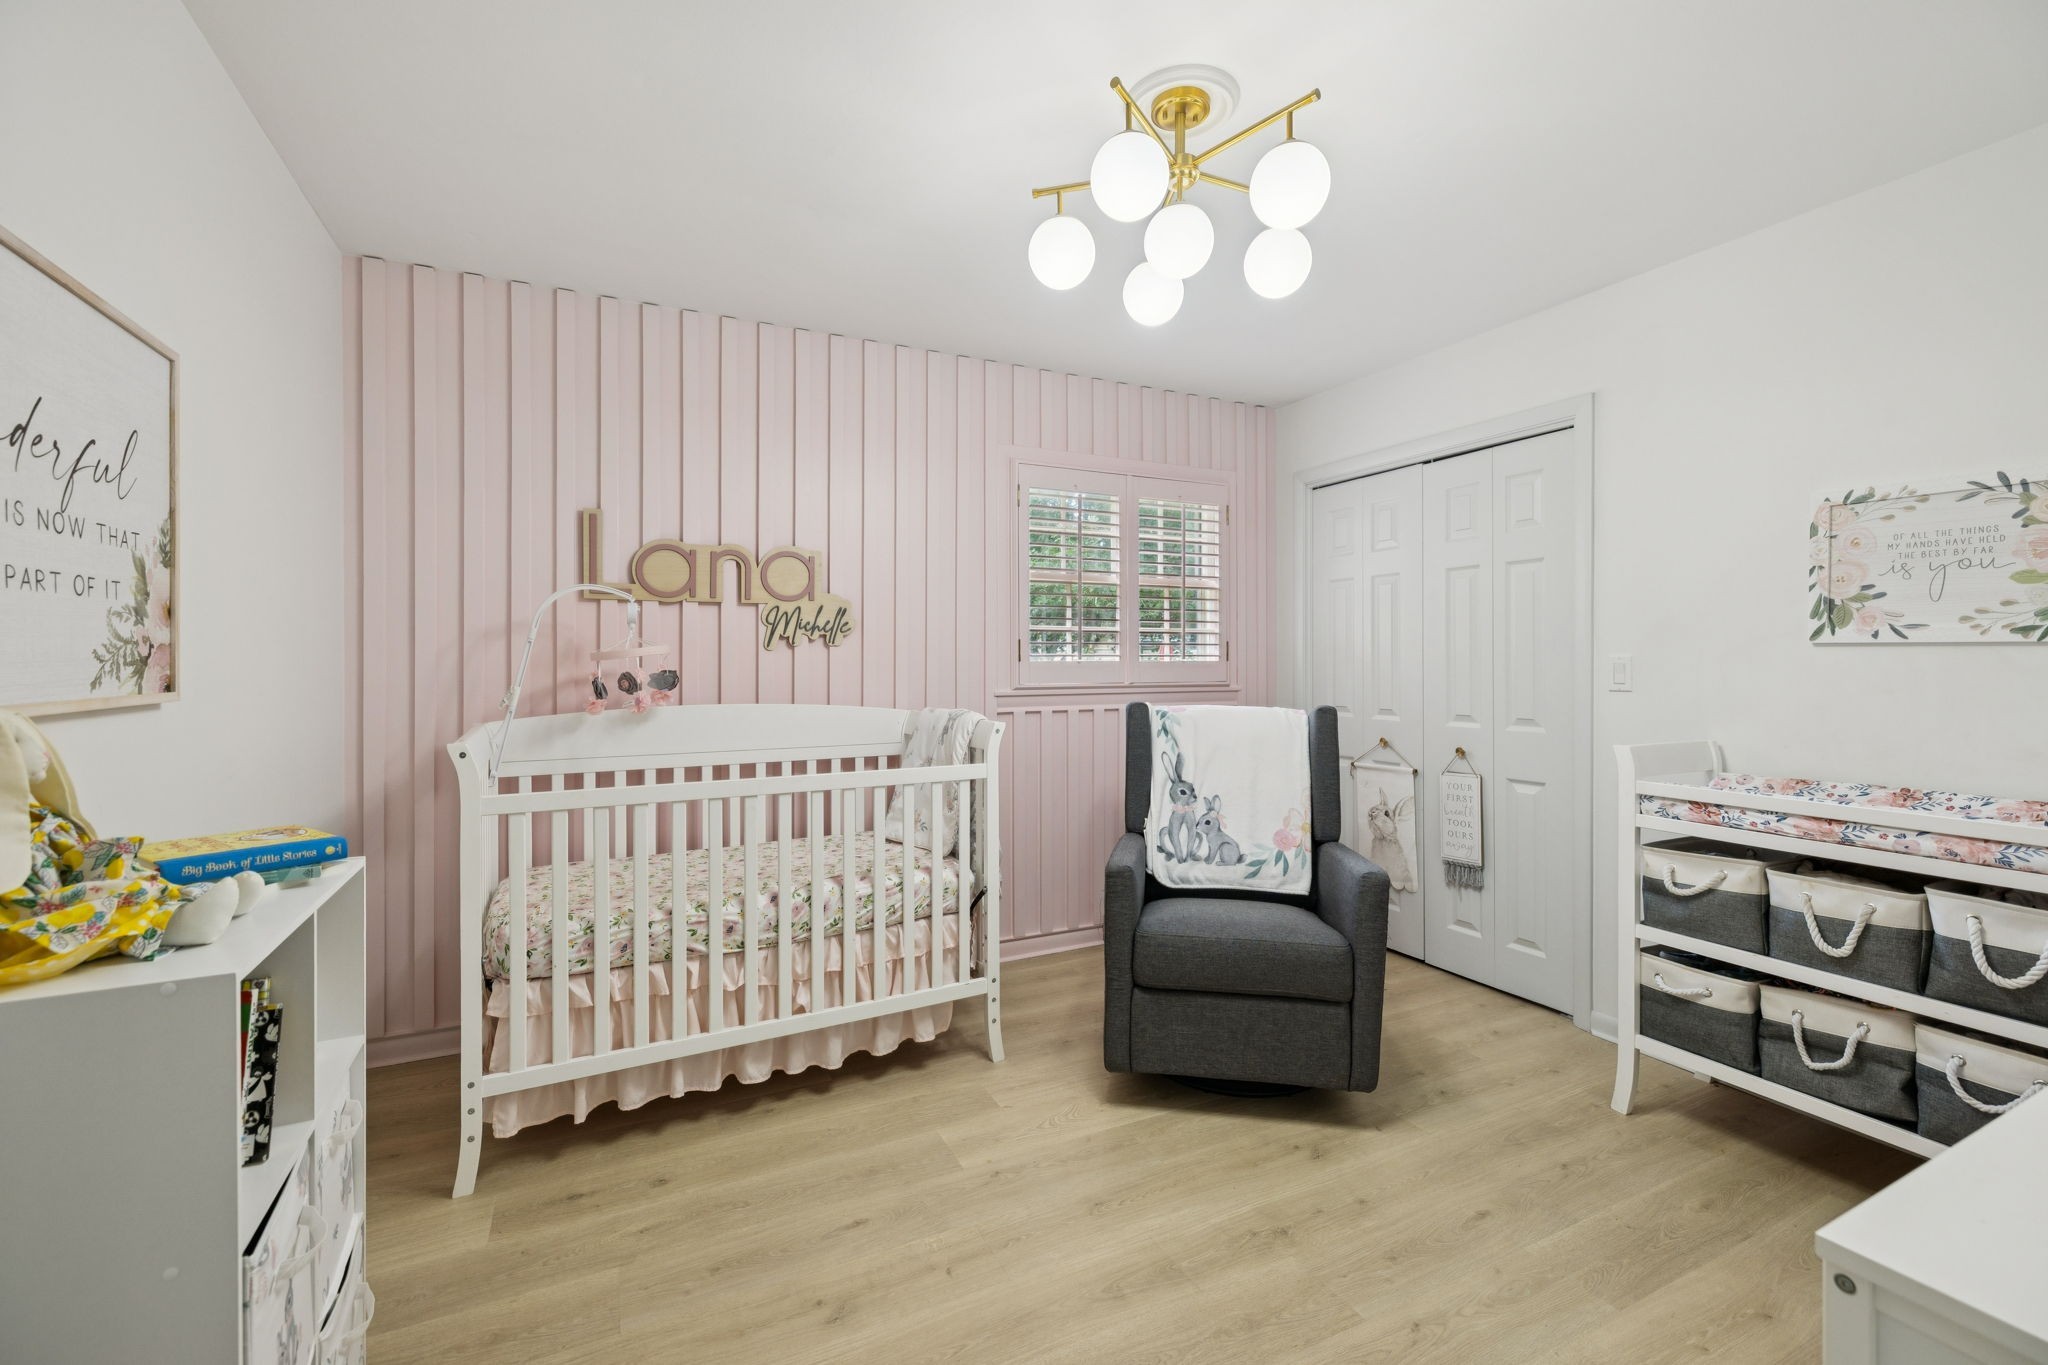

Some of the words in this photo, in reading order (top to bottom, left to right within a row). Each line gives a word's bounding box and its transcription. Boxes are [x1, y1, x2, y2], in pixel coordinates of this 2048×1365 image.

[0, 396, 138, 513] derful
[4, 498, 25, 526] IS
[37, 507, 85, 539] NOW
[96, 522, 140, 551] THAT
[1893, 532, 1905, 541] OF
[1910, 530, 1928, 540] ALL
[1935, 528, 1954, 538] THE
[1959, 524, 2000, 535] THINGS
[1887, 542, 1901, 551] MY
[1905, 539, 1940, 549] HANDS
[1945, 536, 1973, 547] HAVE
[1979, 534, 2006, 544] HELD
[1898, 551, 1915, 560] THE
[1921, 548, 1948, 559] BEST
[1953, 547, 1968, 557] BY
[1973, 545, 1995, 555] FAR
[587, 511, 818, 603] Lana
[5, 563, 61, 594] PART
[73, 574, 95, 597] OF
[105, 578, 120, 600] IT
[1878, 559, 1915, 581] is
[1928, 557, 2017, 602] you
[764, 605, 852, 646] Michelle
[1446, 781, 1473, 792] YOUR
[1446, 793, 1473, 804] FIRST
[1447, 818, 1473, 829] TOOK
[1447, 829, 1474, 841] OURS
[182, 865, 203, 878] Big
[205, 860, 238, 873] Book
[240, 857, 253, 870] of
[254, 853, 281, 866] Little
[282, 848, 317, 861] Stories
